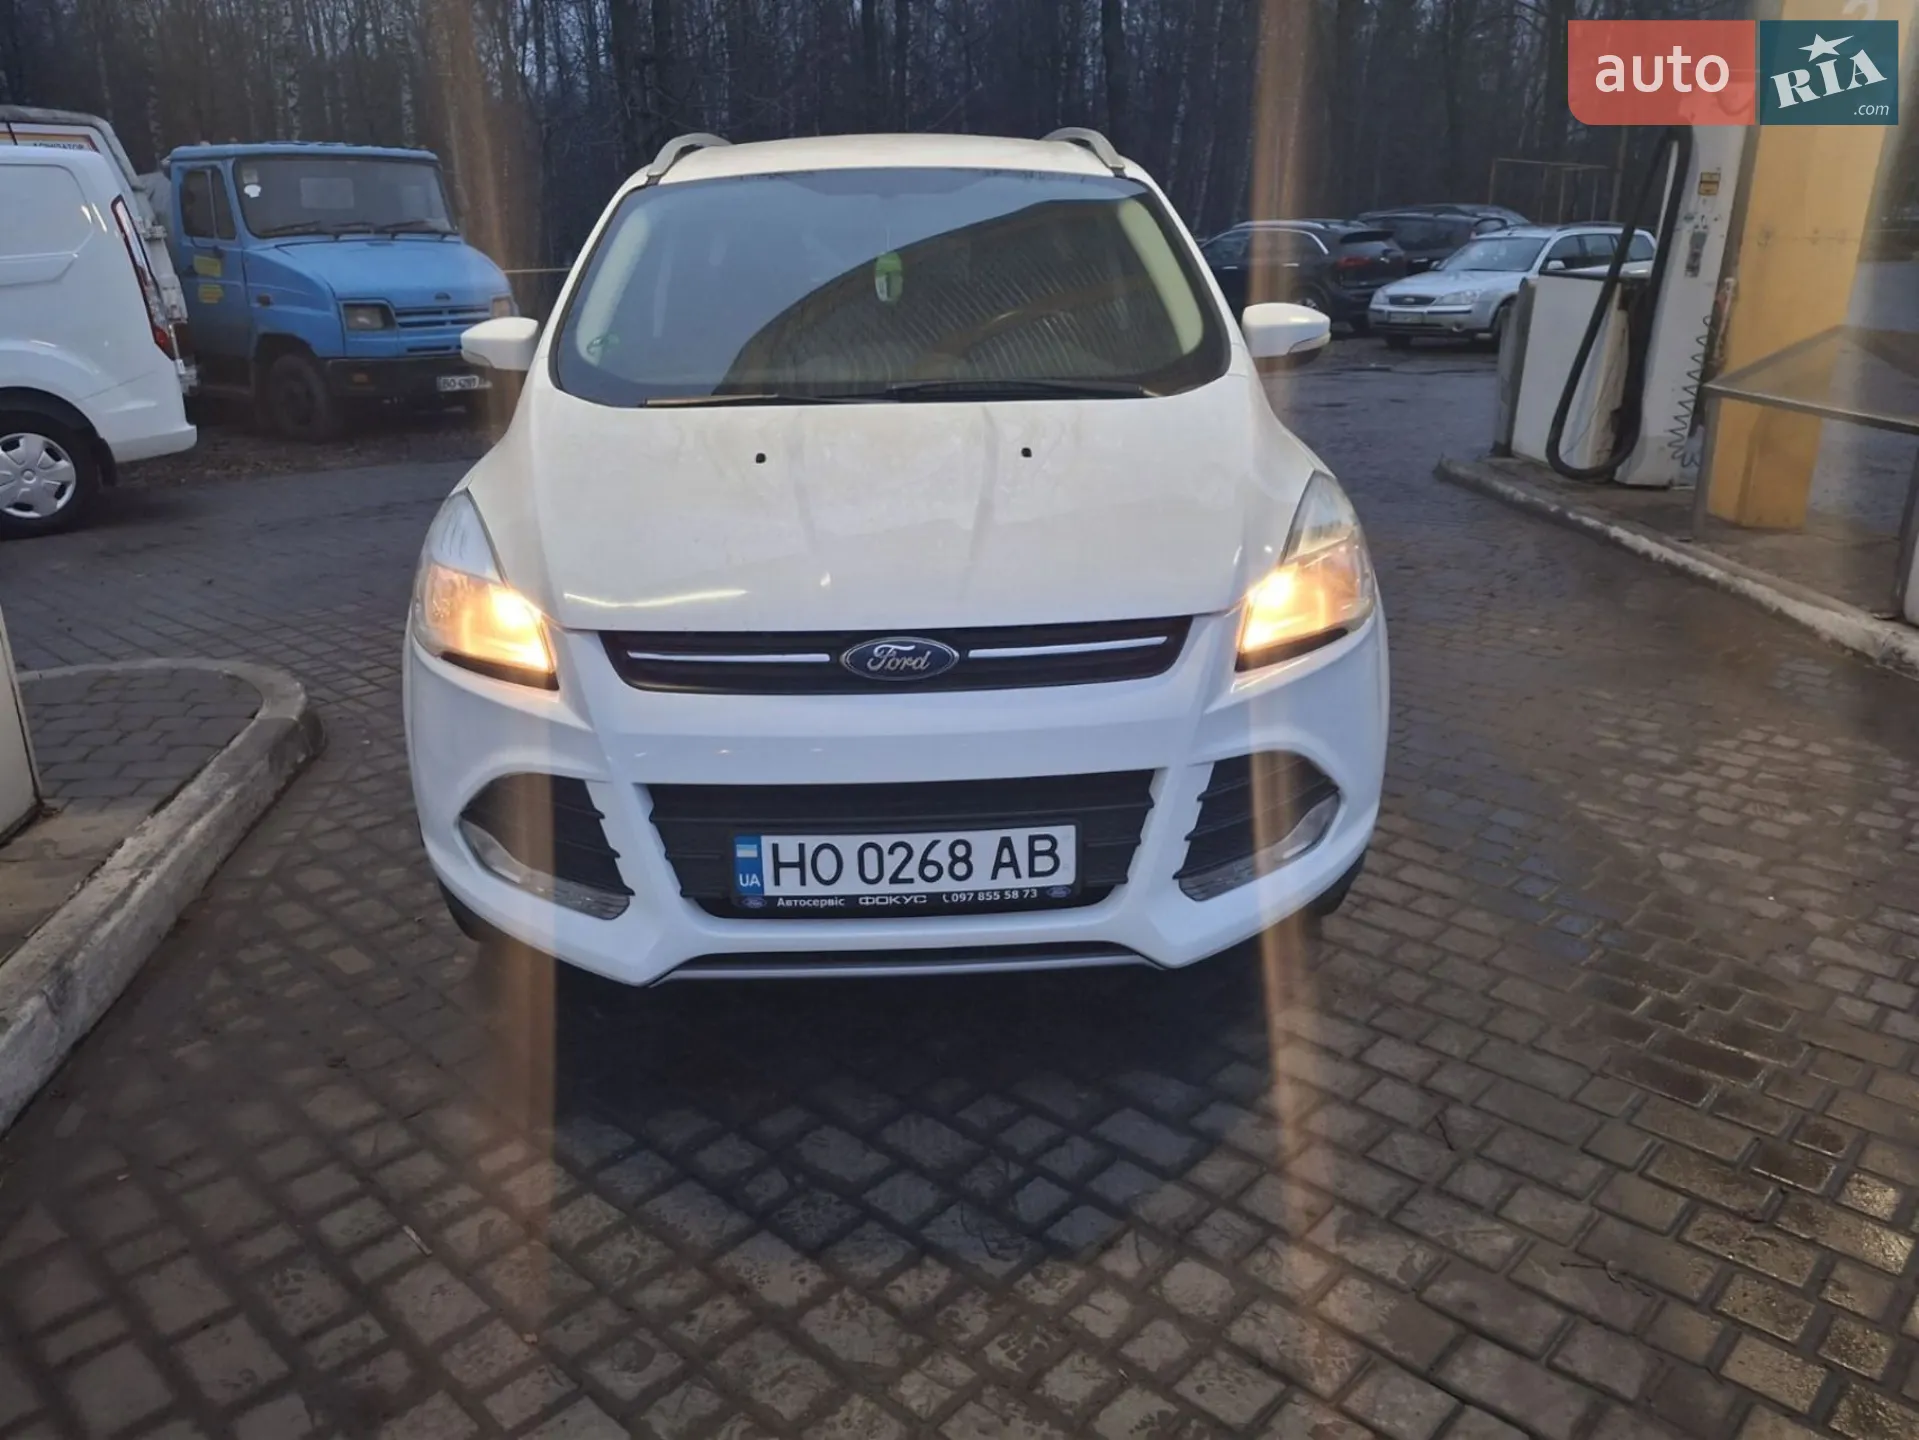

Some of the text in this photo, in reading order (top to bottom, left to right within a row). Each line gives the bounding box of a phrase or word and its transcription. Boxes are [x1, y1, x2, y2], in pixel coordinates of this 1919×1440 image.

[866, 643, 932, 672] Ford
[771, 833, 1061, 888] HO 0268 AB
[739, 873, 762, 888] UA
[776, 896, 845, 908] Автосервіс
[858, 894, 928, 906] ФОКУС
[951, 892, 974, 903] 097
[977, 890, 1001, 901] 855
[1003, 889, 1020, 900] 58
[1022, 888, 1038, 899] 73
